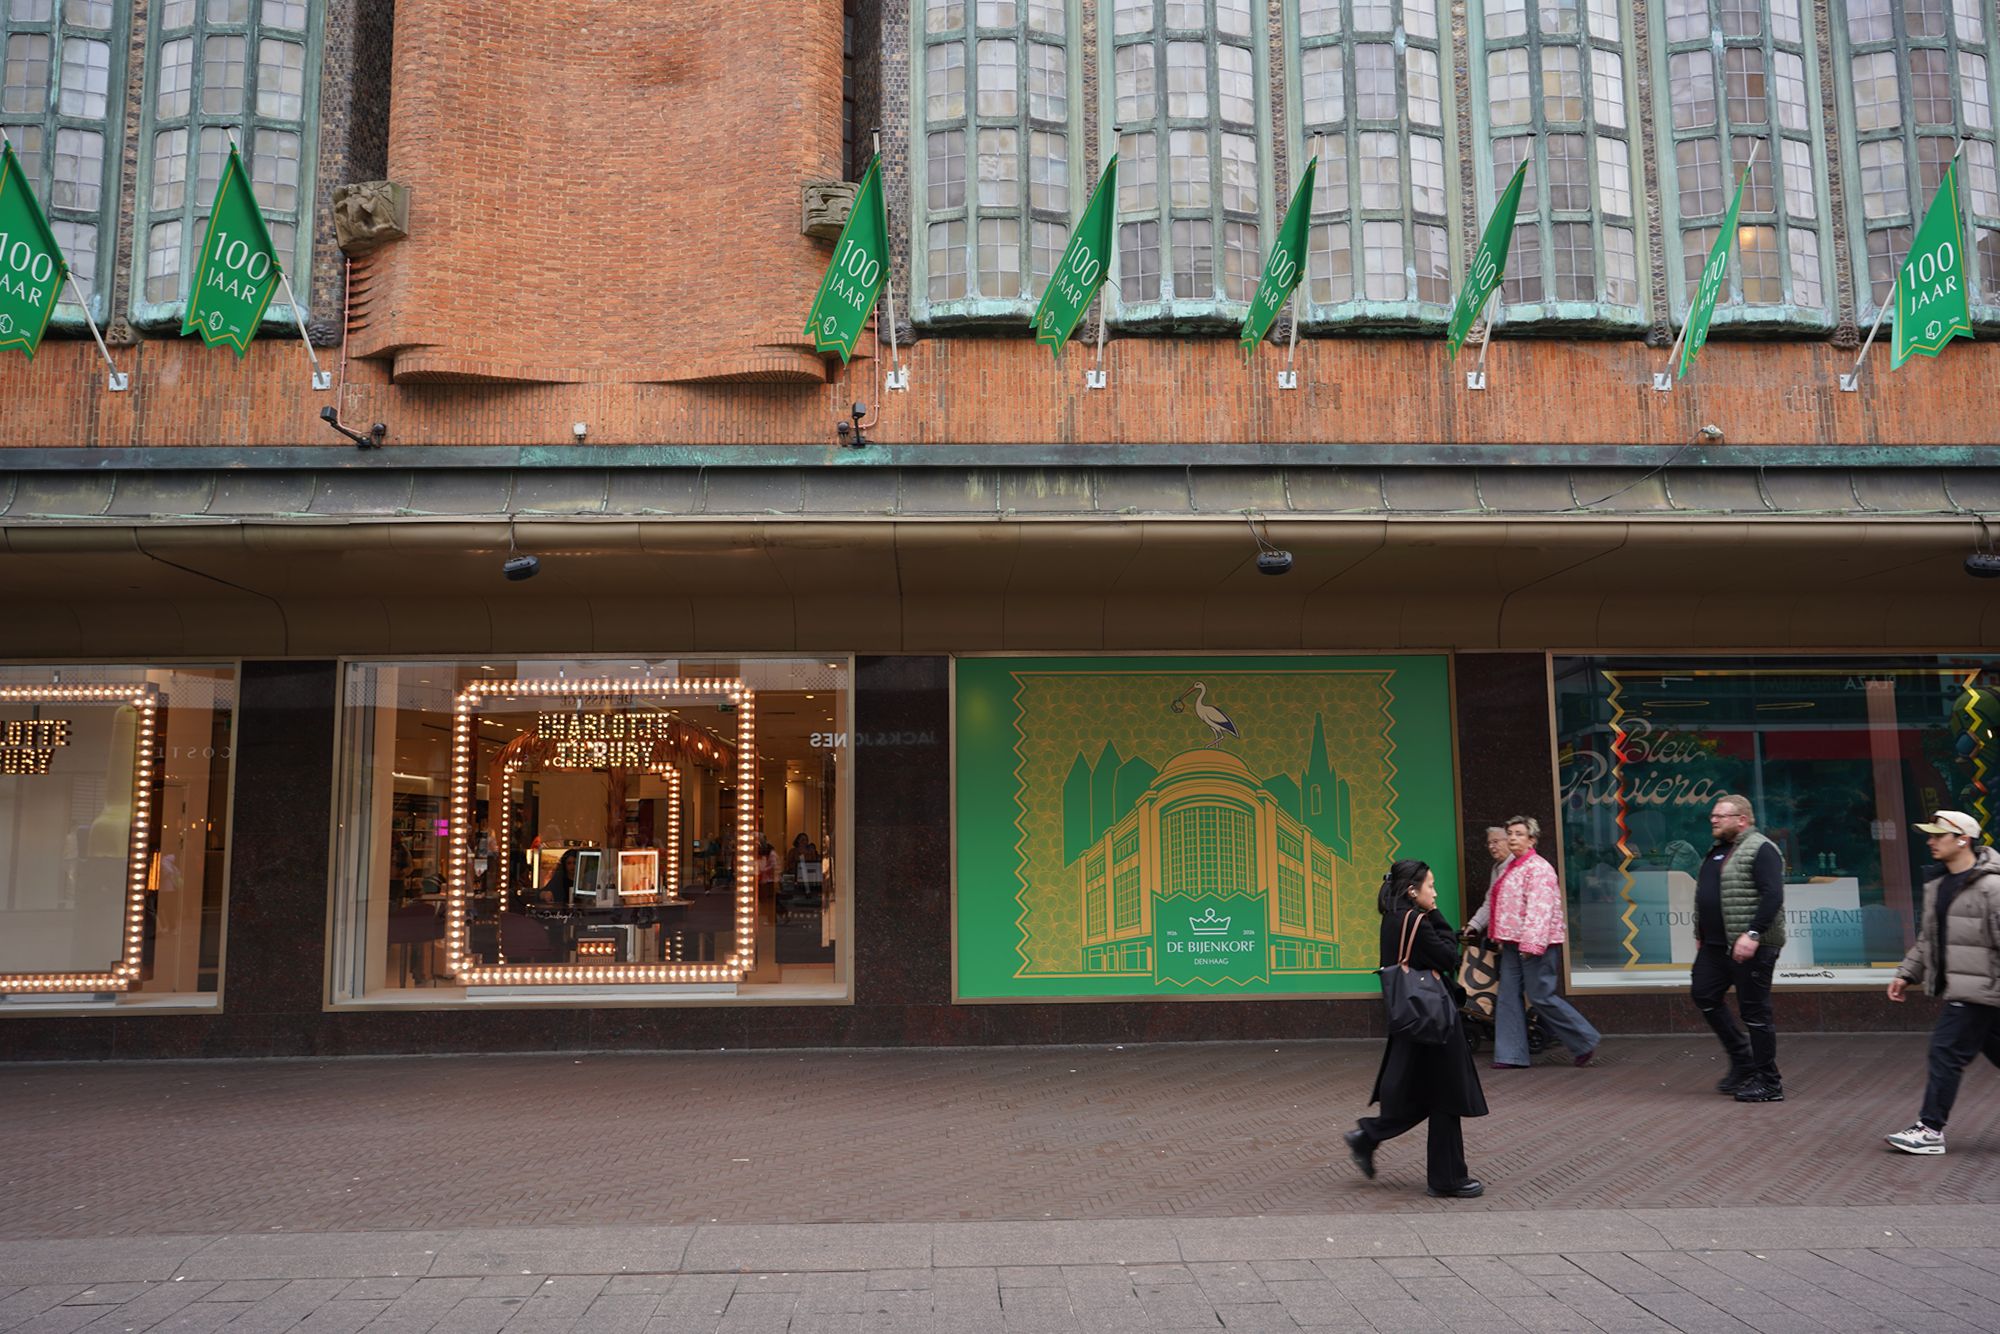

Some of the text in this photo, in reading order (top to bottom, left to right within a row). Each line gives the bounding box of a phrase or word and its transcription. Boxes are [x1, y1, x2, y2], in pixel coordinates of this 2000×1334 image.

[0, 232, 53, 283] 100
[215, 232, 271, 281] 100
[840, 239, 880, 288] 100
[1068, 237, 1100, 287] 100
[1269, 241, 1297, 288] 100
[1474, 242, 1497, 291] 100
[1905, 242, 1954, 290] 100
[206, 267, 256, 304] JAAR
[828, 272, 865, 312] JAAR
[1056, 269, 1082, 309] JAAR
[1260, 277, 1279, 311] AAR
[1910, 275, 1957, 316] JAAR
[538, 713, 670, 739] CHARLOTTE
[1619, 717, 1708, 764] Bleu
[0, 749, 54, 774] URY
[557, 742, 654, 768] TILBURY
[1559, 750, 1729, 807] Riviera
[1640, 911, 1698, 927] A TOUC
[1167, 941, 1255, 954] DE BIJENKORF
